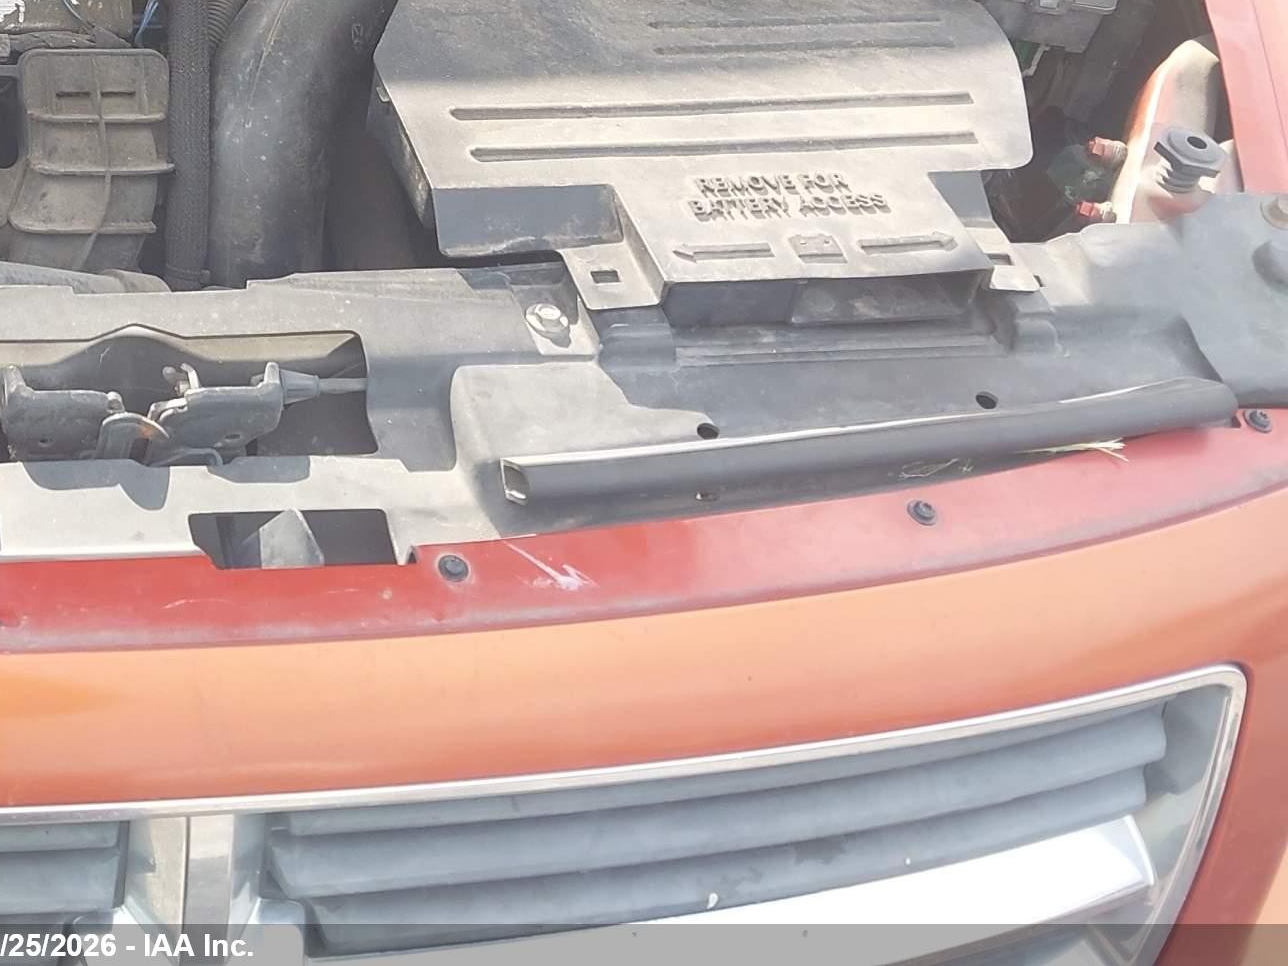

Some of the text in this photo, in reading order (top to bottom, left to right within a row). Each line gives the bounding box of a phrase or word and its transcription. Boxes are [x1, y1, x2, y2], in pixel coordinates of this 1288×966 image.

[695, 169, 853, 198] REMOVE FOR
[687, 193, 893, 223] BATTERY ACCESS
